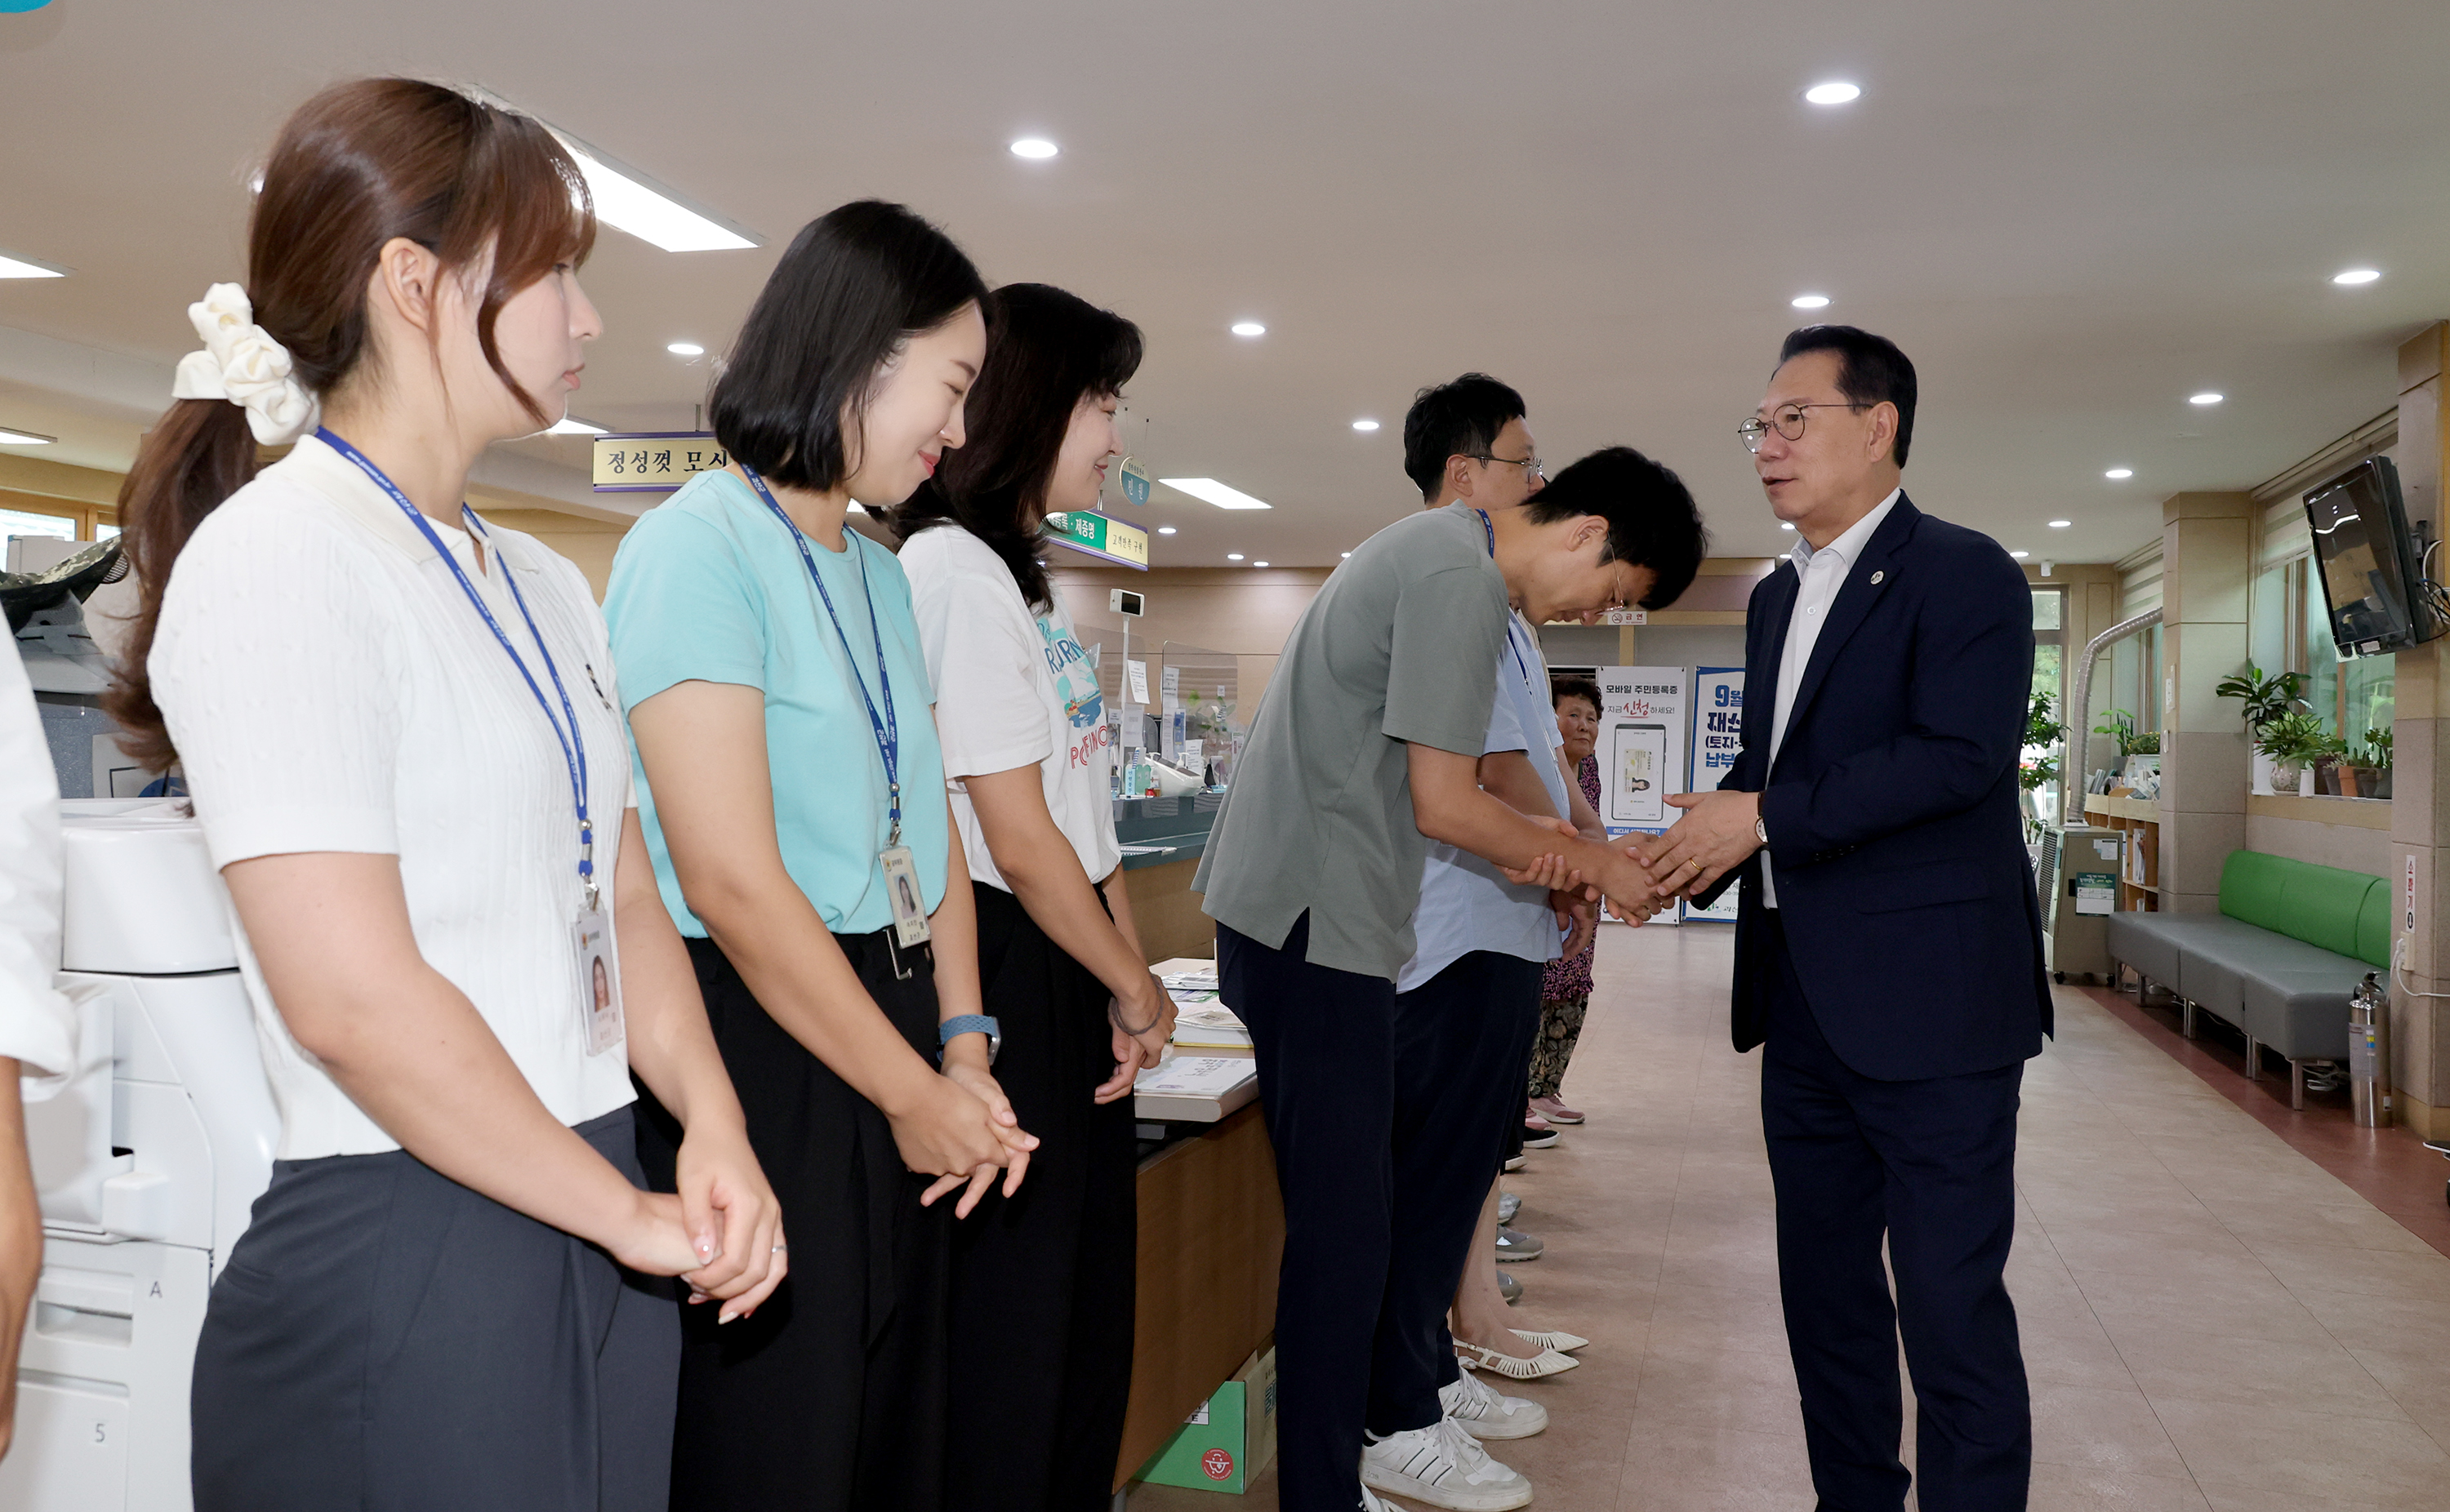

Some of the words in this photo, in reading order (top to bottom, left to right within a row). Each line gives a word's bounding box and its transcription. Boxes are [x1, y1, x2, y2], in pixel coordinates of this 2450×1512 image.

[608, 450, 670, 474] 정성껏
[1606, 685, 1632, 694] 모바일
[1634, 685, 1677, 695] 주민등록증
[1715, 685, 1743, 707] 9월
[1607, 705, 1623, 714] 지금
[1623, 699, 1649, 716] 신청
[1650, 706, 1675, 714] 하세요!
[1705, 735, 1743, 749] (토지·
[1705, 752, 1735, 768] 납부
[149, 1281, 163, 1298] A
[95, 1423, 105, 1443] 5
